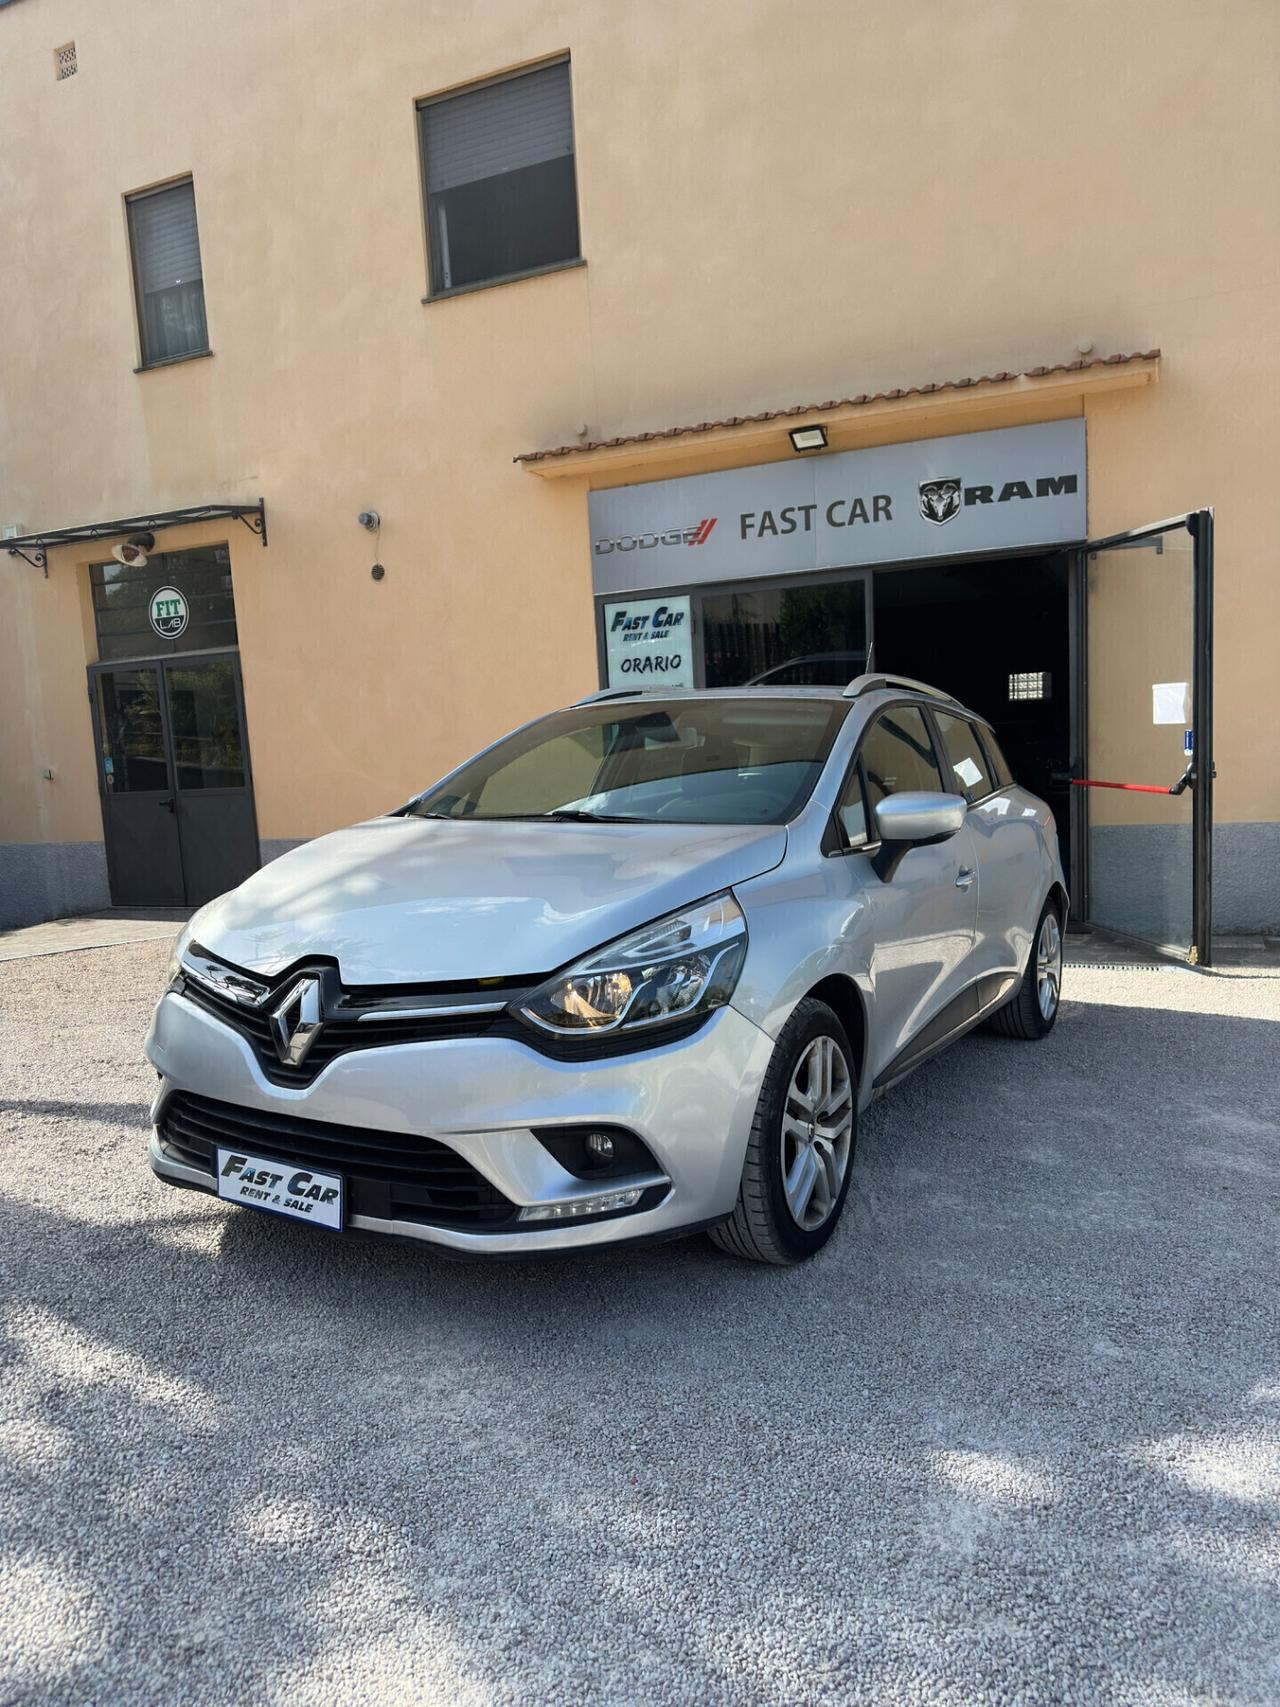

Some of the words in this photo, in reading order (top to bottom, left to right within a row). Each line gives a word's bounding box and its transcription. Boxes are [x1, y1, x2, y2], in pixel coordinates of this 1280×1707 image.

[964, 474, 1078, 506] RAM
[739, 504, 818, 540] FAST
[825, 494, 893, 528] CAR
[594, 524, 703, 556] DODGE
[155, 598, 181, 618] FIT
[160, 617, 181, 630] LAB
[623, 631, 643, 642] RENT
[651, 629, 670, 640] SALE
[620, 654, 682, 674] ORARIO
[240, 1185, 271, 1202] RENT
[271, 1194, 281, 1205] &
[283, 1197, 314, 1214] SALE
